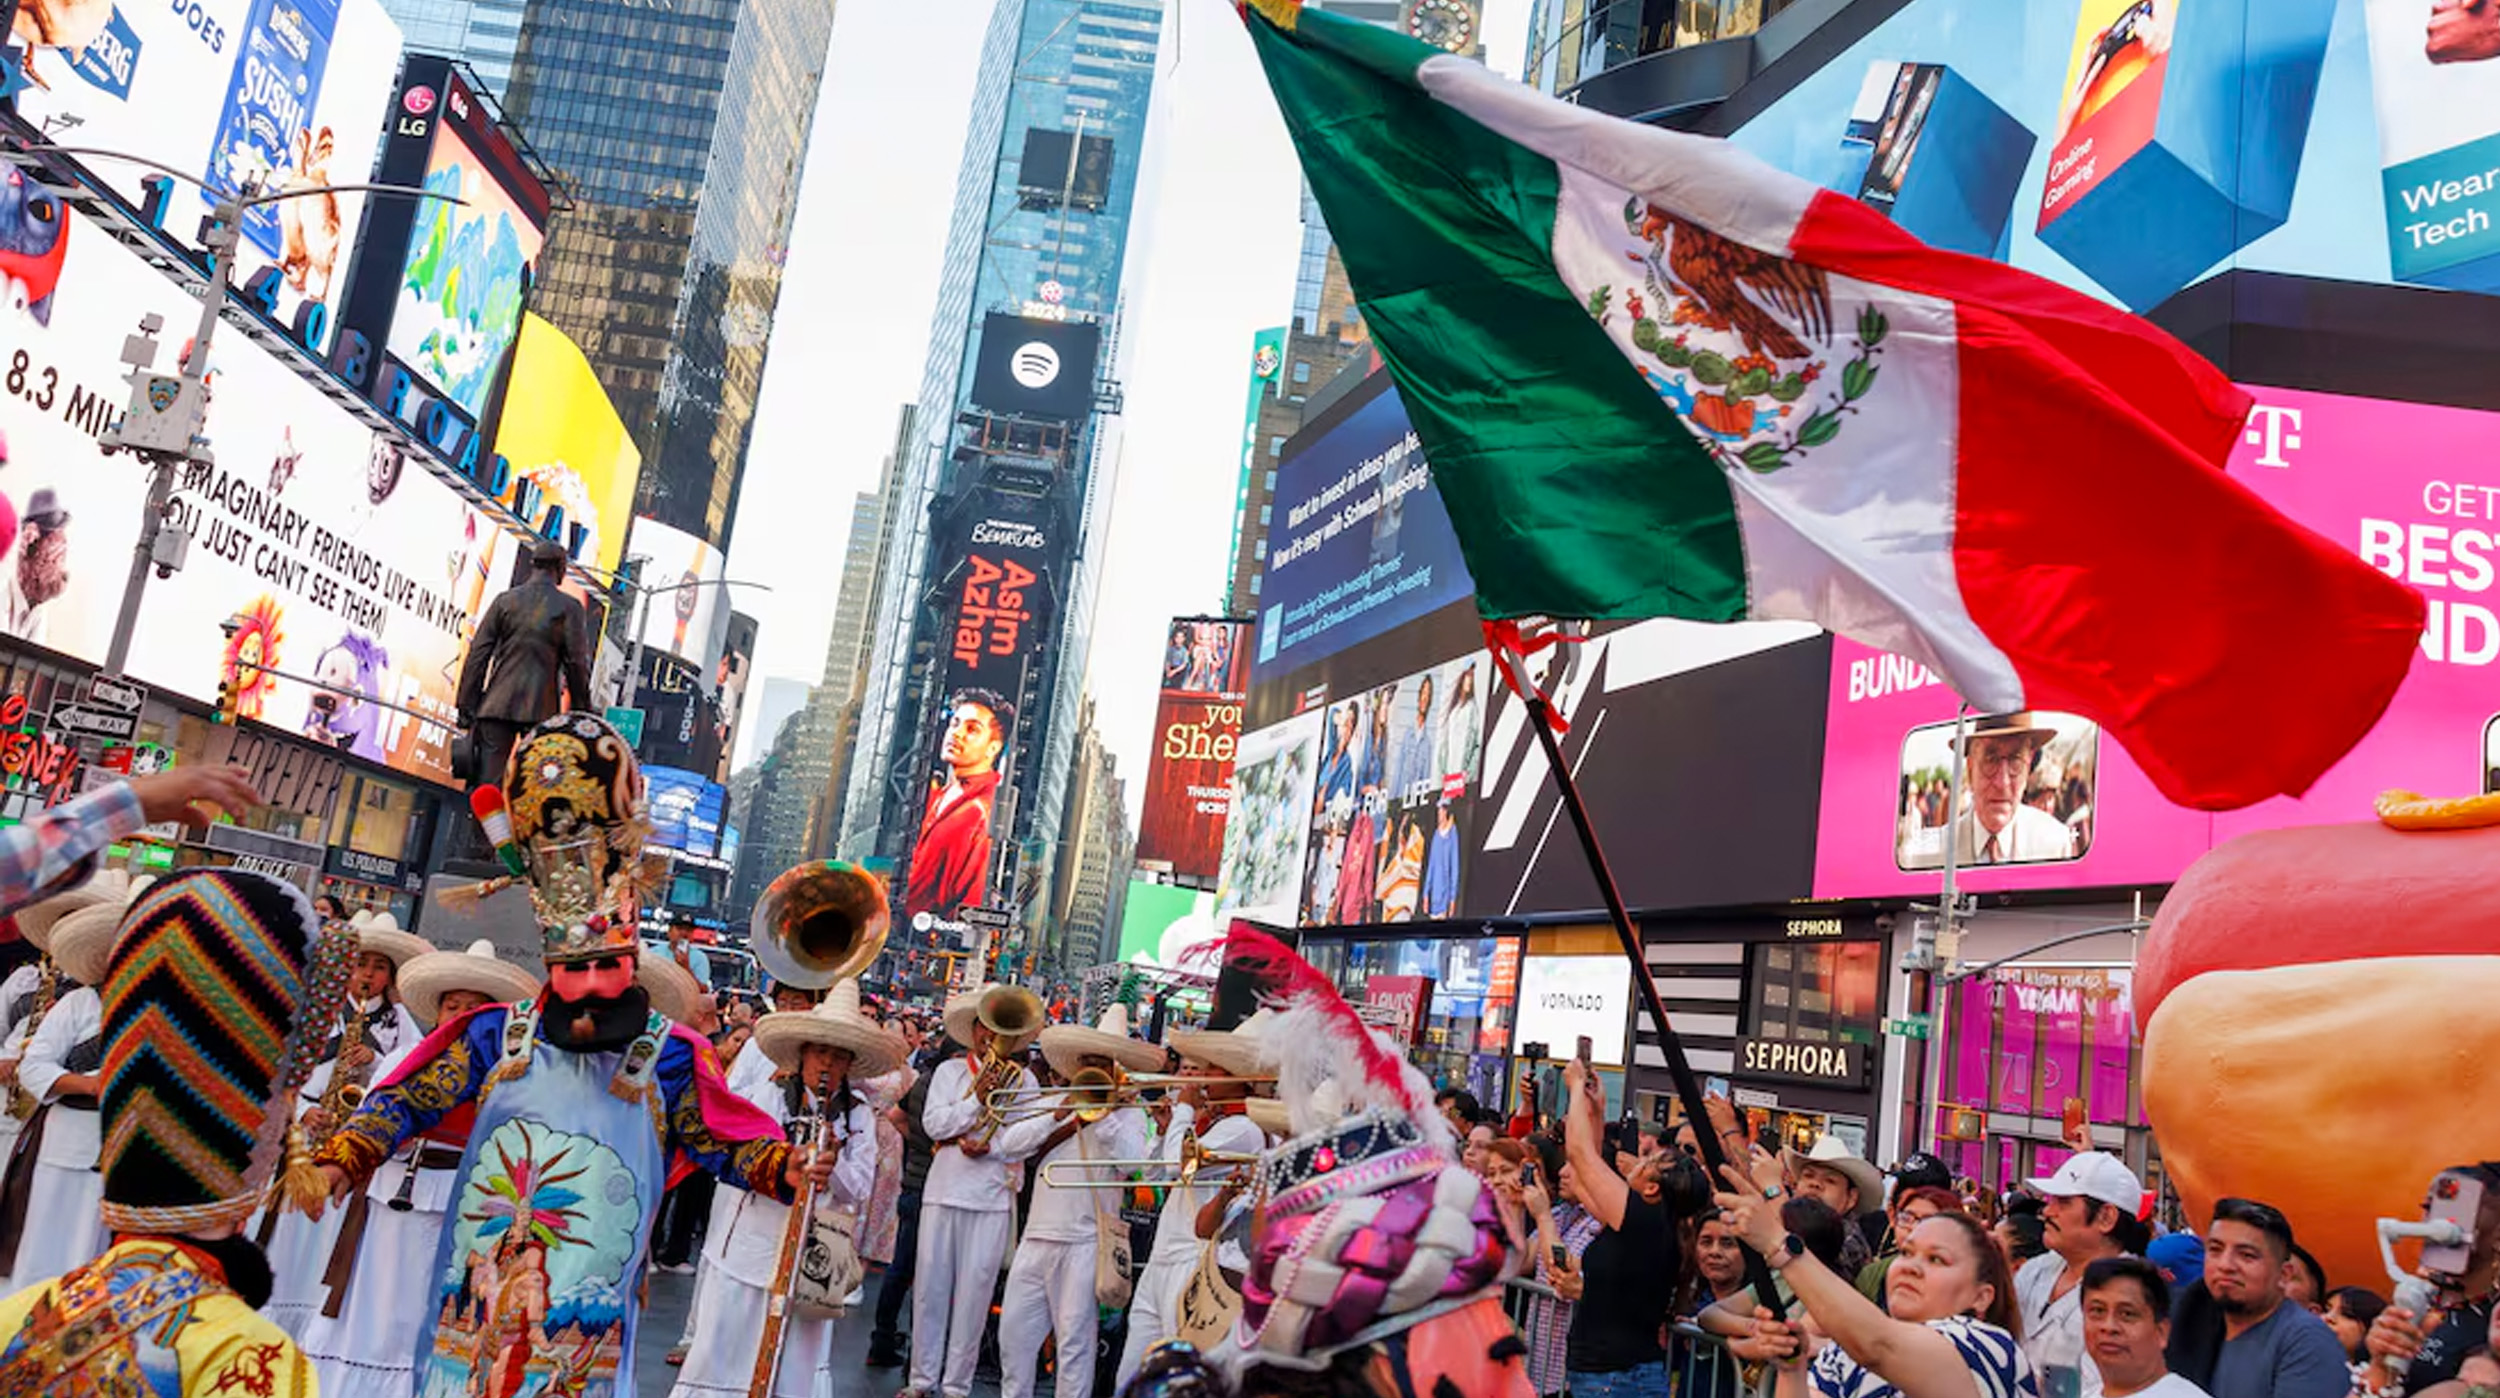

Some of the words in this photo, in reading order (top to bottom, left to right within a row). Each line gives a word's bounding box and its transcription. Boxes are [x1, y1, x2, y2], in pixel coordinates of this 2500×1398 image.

[238, 56, 305, 150] SUSHI
[398, 117, 427, 136] LG
[2044, 155, 2097, 209] Gaming
[2050, 137, 2094, 182] Online
[2401, 167, 2500, 213] Wear
[2404, 208, 2489, 249] Tech
[1022, 301, 1067, 322] 2024
[6, 349, 58, 412] 8.3
[333, 329, 589, 560] BROADWAY
[1320, 476, 1347, 509] invest
[1357, 455, 1384, 486] ideas
[1383, 441, 1405, 475] you
[1343, 489, 1382, 528] Schwab
[2422, 480, 2500, 521] GET
[202, 516, 253, 567] JUST
[254, 543, 309, 596] CAN'T
[308, 572, 340, 612] SEE
[309, 525, 381, 592] FRIENDS
[383, 566, 416, 611] LIVE
[416, 588, 437, 620] IN
[436, 597, 468, 640] NYC
[953, 554, 1002, 670] Azhar
[989, 559, 1037, 656] Asim
[61, 711, 87, 724] ONE
[98, 718, 128, 732] WAY
[1164, 724, 1237, 763] She
[226, 727, 347, 819] FOREVER
[1402, 778, 1431, 809] LIFE
[1786, 919, 1842, 937] SEPHORA
[1540, 992, 1604, 1012] VORNADO
[1744, 1041, 1848, 1077] SEPHORA
